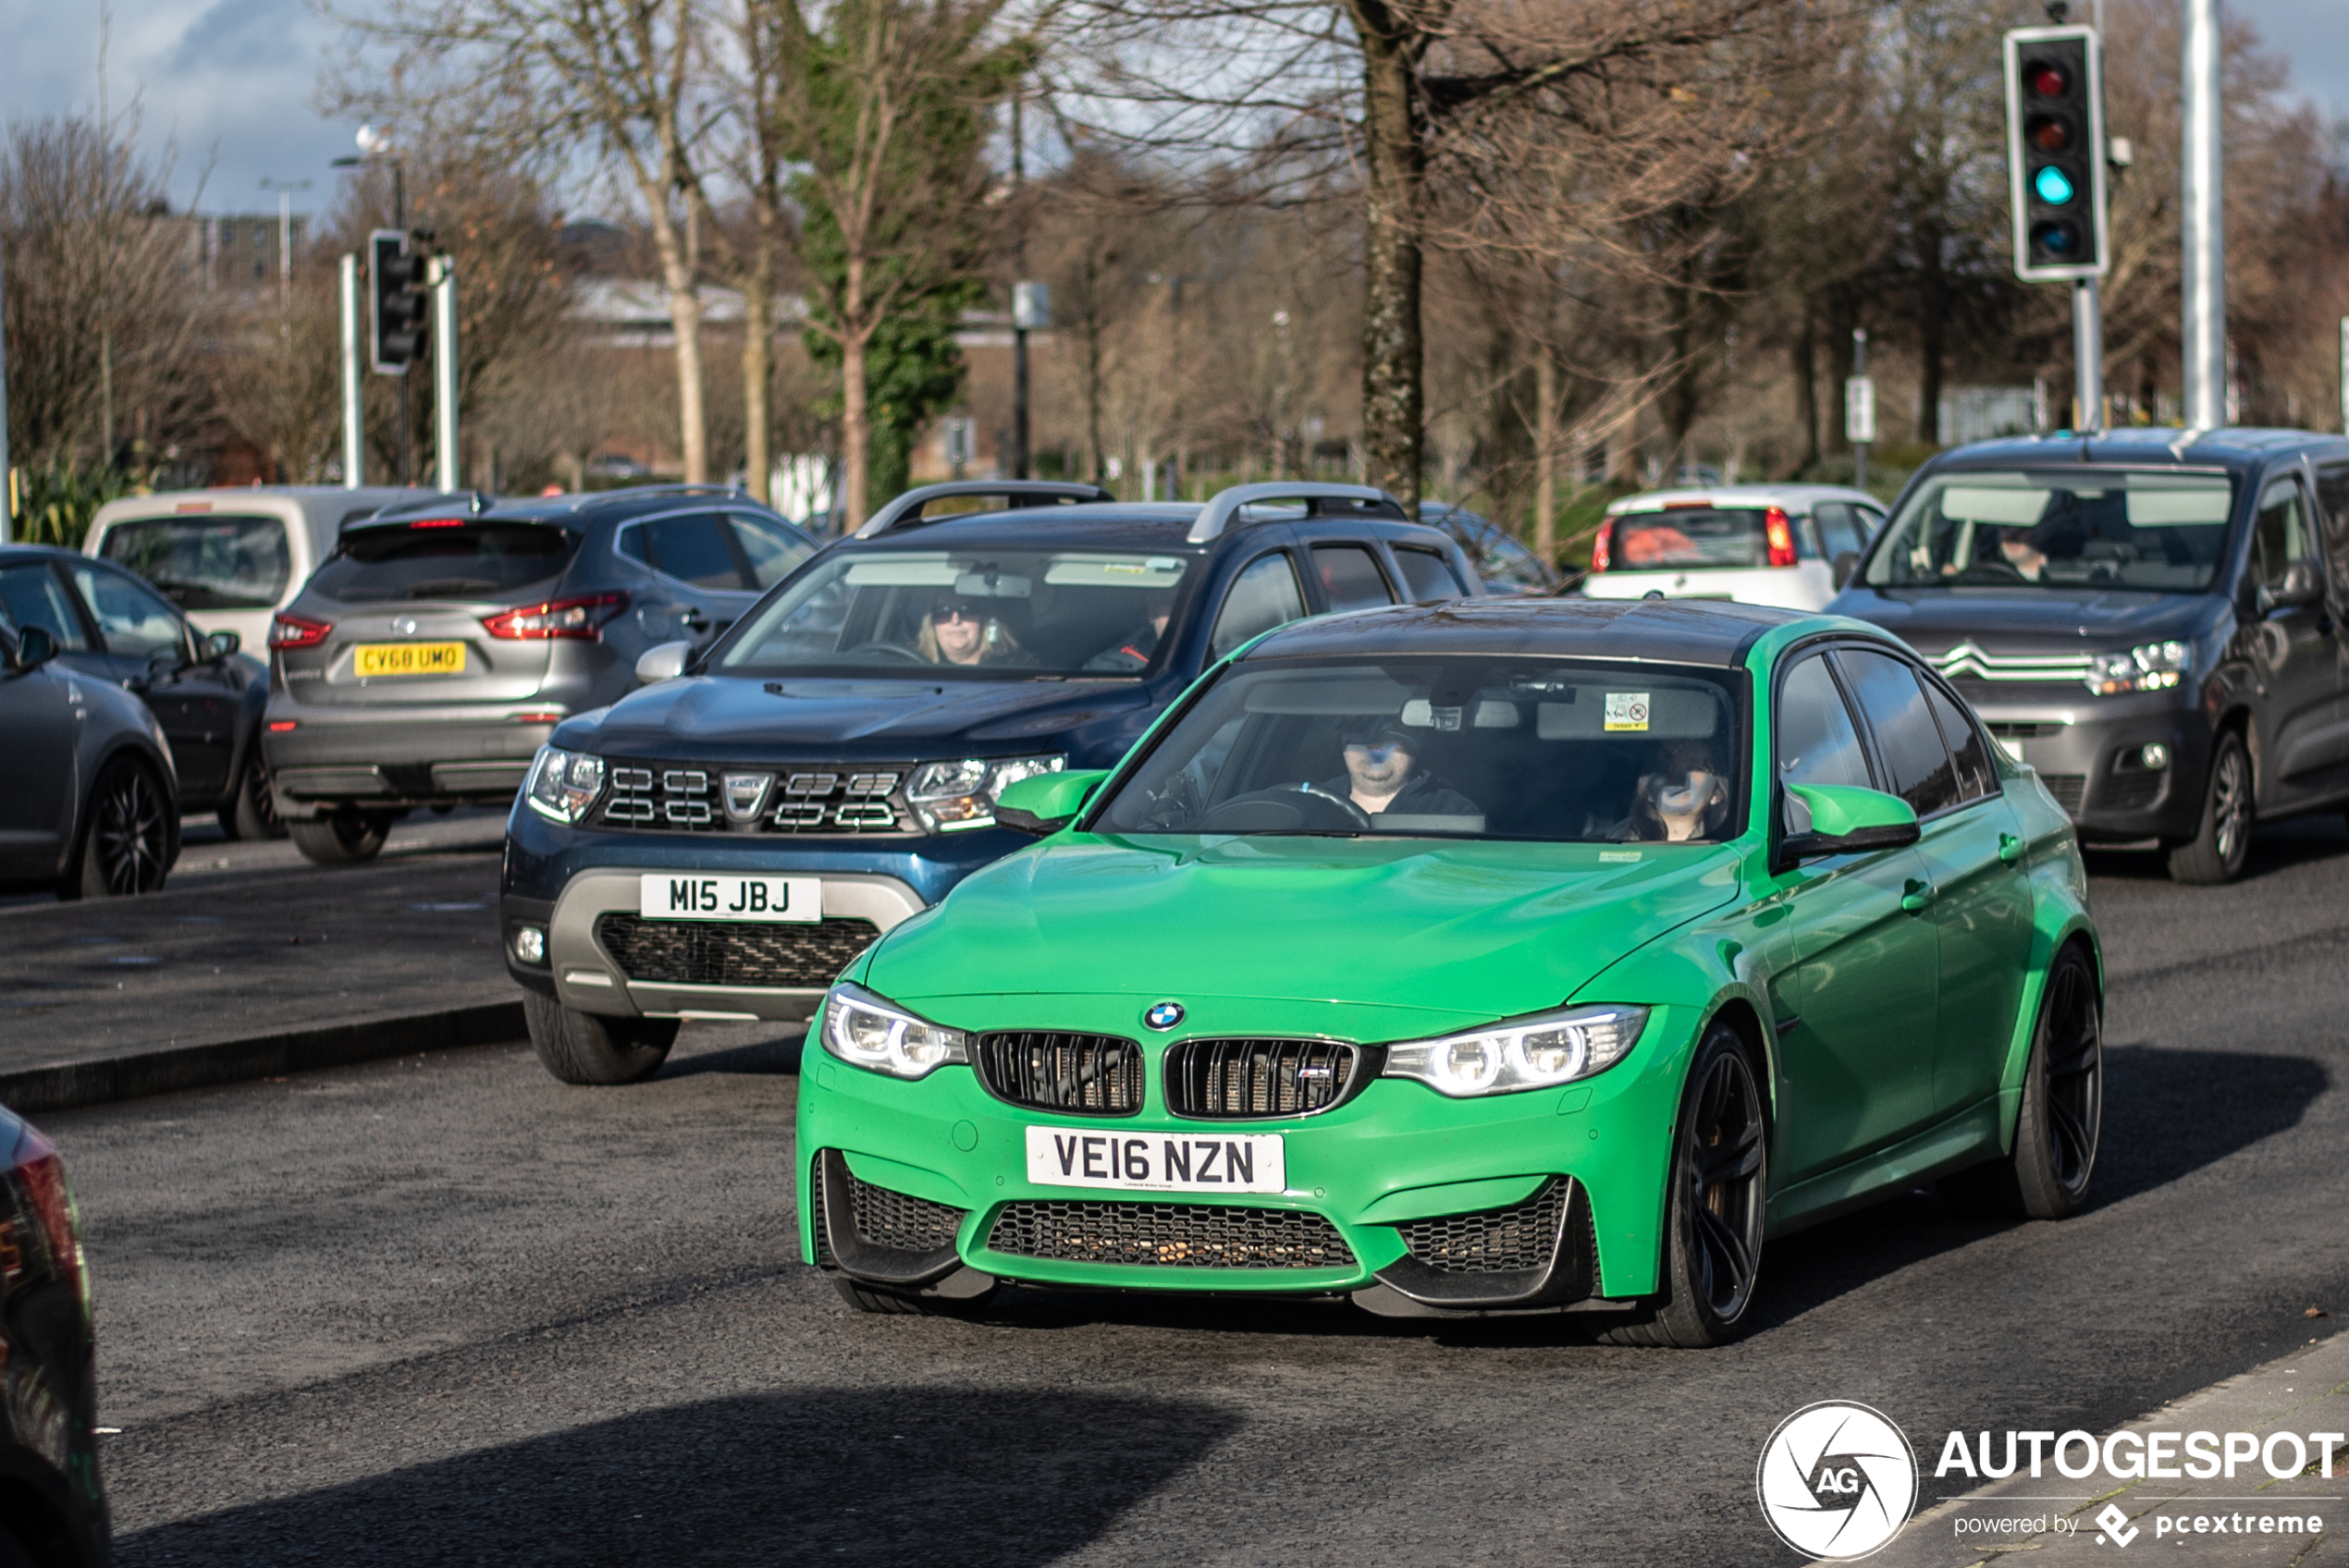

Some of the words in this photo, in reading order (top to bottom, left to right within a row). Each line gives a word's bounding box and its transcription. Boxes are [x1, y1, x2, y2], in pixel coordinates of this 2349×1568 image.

[363, 650, 412, 669] CV68
[419, 647, 456, 667] UMO
[670, 879, 718, 911] M15
[729, 881, 790, 912] JBJ
[1054, 1134, 1150, 1180] VE16
[1164, 1140, 1254, 1183] NZN
